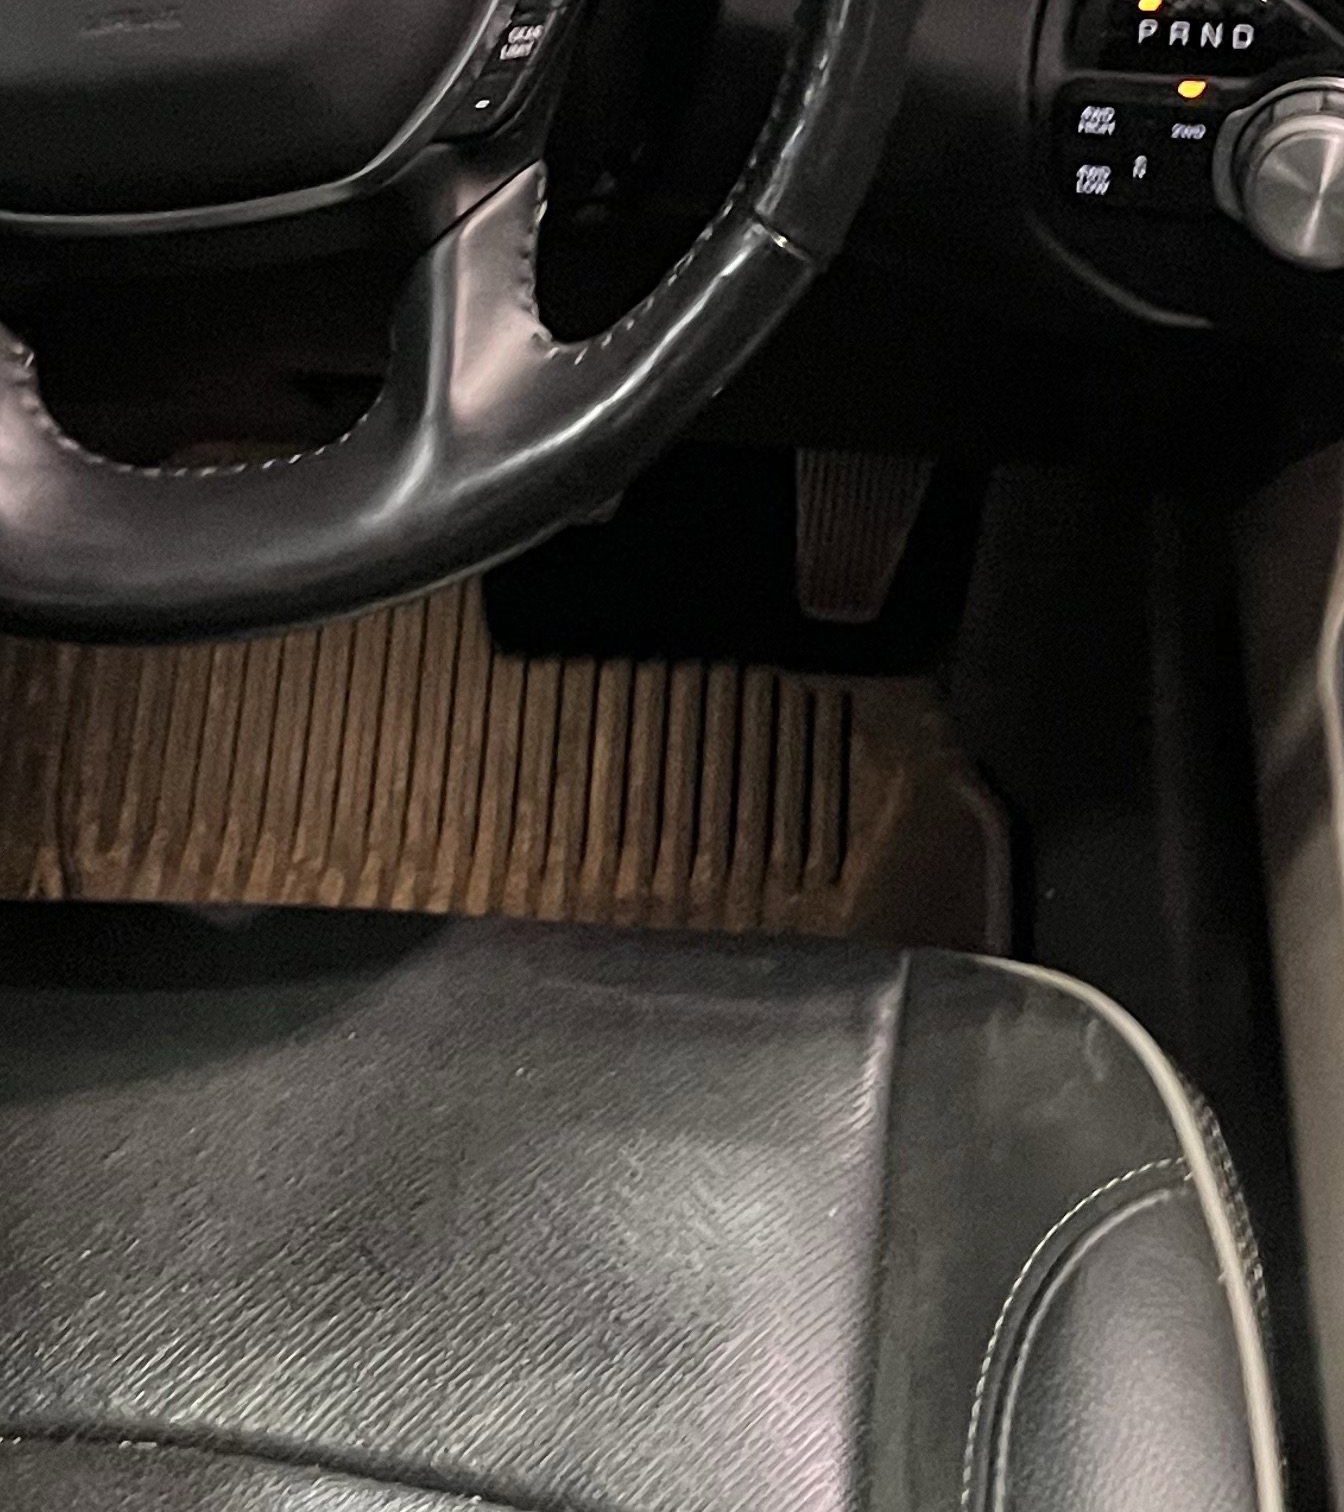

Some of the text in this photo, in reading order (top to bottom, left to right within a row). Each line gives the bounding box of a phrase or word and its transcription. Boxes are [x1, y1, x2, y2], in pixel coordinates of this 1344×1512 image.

[1137, 18, 1159, 44] P
[1200, 21, 1223, 49] N
[1232, 23, 1255, 50] D
